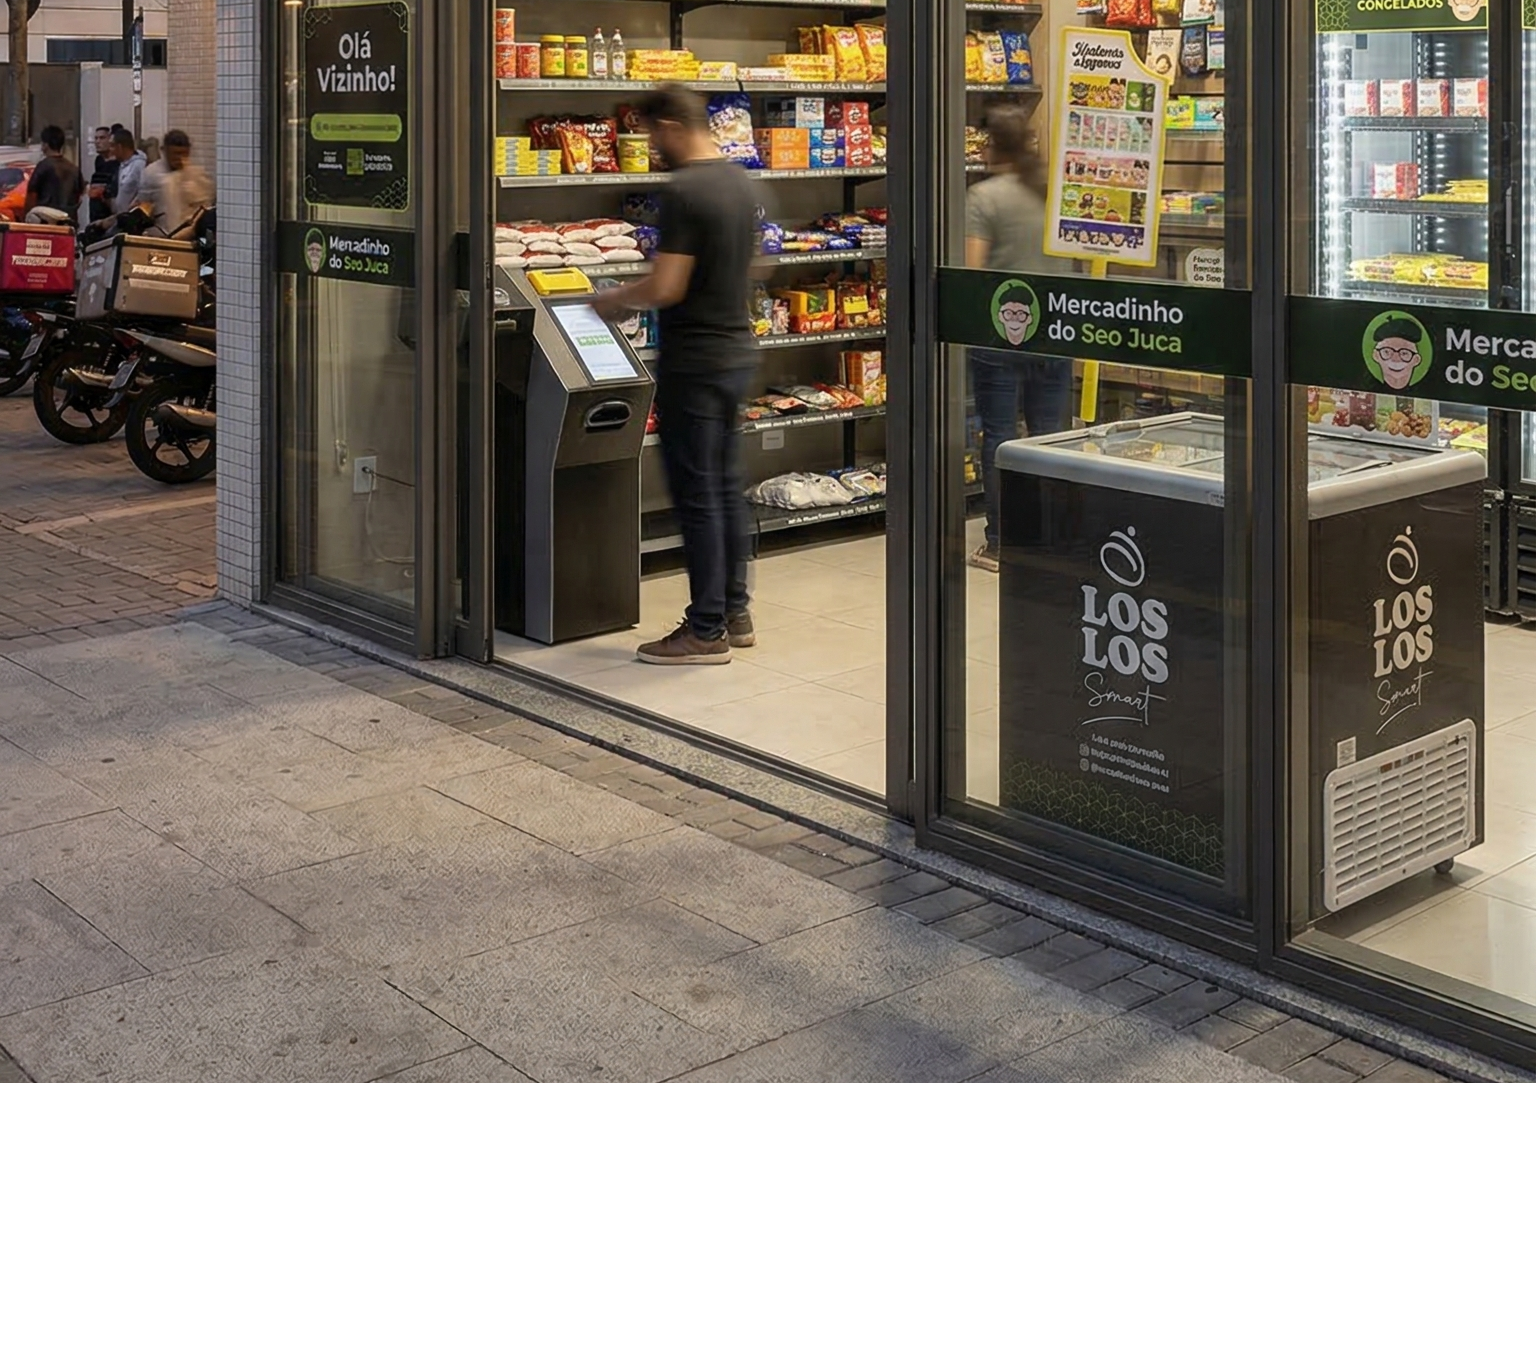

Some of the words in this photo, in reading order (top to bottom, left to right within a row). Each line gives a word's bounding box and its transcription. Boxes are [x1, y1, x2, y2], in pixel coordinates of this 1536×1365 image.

[339, 31, 371, 59] Olá
[317, 64, 396, 92] Vizinho!
[329, 254, 343, 269] do
[344, 256, 363, 271] Seo
[364, 257, 389, 274] Juca
[1048, 292, 1184, 324] Mercadinho
[1048, 320, 1076, 341] do
[1081, 323, 1122, 346] Seo
[1127, 328, 1182, 353] Juca
[1445, 360, 1484, 386] do
[1081, 585, 1168, 640] LOS
[1373, 585, 1433, 637] LOS
[1081, 627, 1169, 683] LOS
[1373, 624, 1433, 677] LOS
[1084, 671, 1167, 726] Smart
[1376, 667, 1434, 716] Smart
